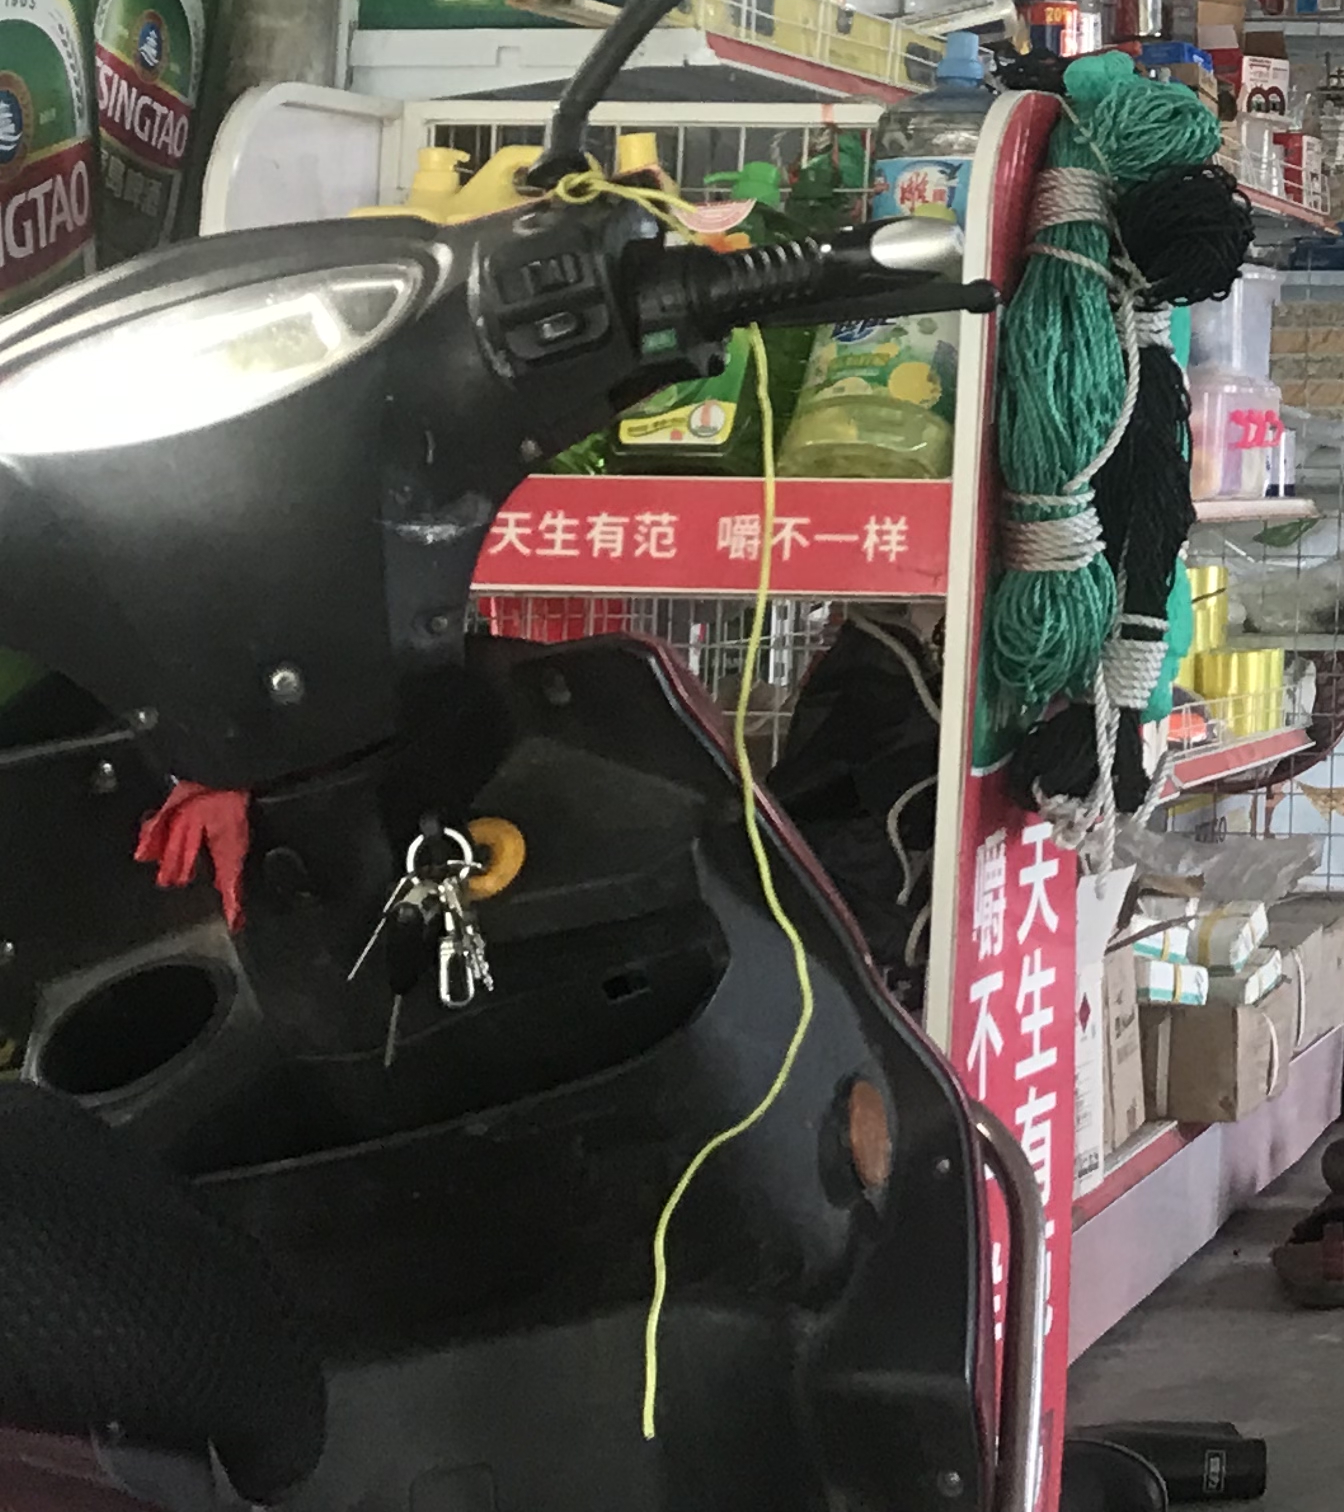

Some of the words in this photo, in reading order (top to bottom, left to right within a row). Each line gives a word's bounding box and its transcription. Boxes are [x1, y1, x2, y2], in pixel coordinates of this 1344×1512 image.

[96, 55, 190, 159] SINGTAO
[0, 159, 90, 268] GTAO
[488, 510, 679, 560] 天生有范
[717, 514, 909, 563] 嚼不一样
